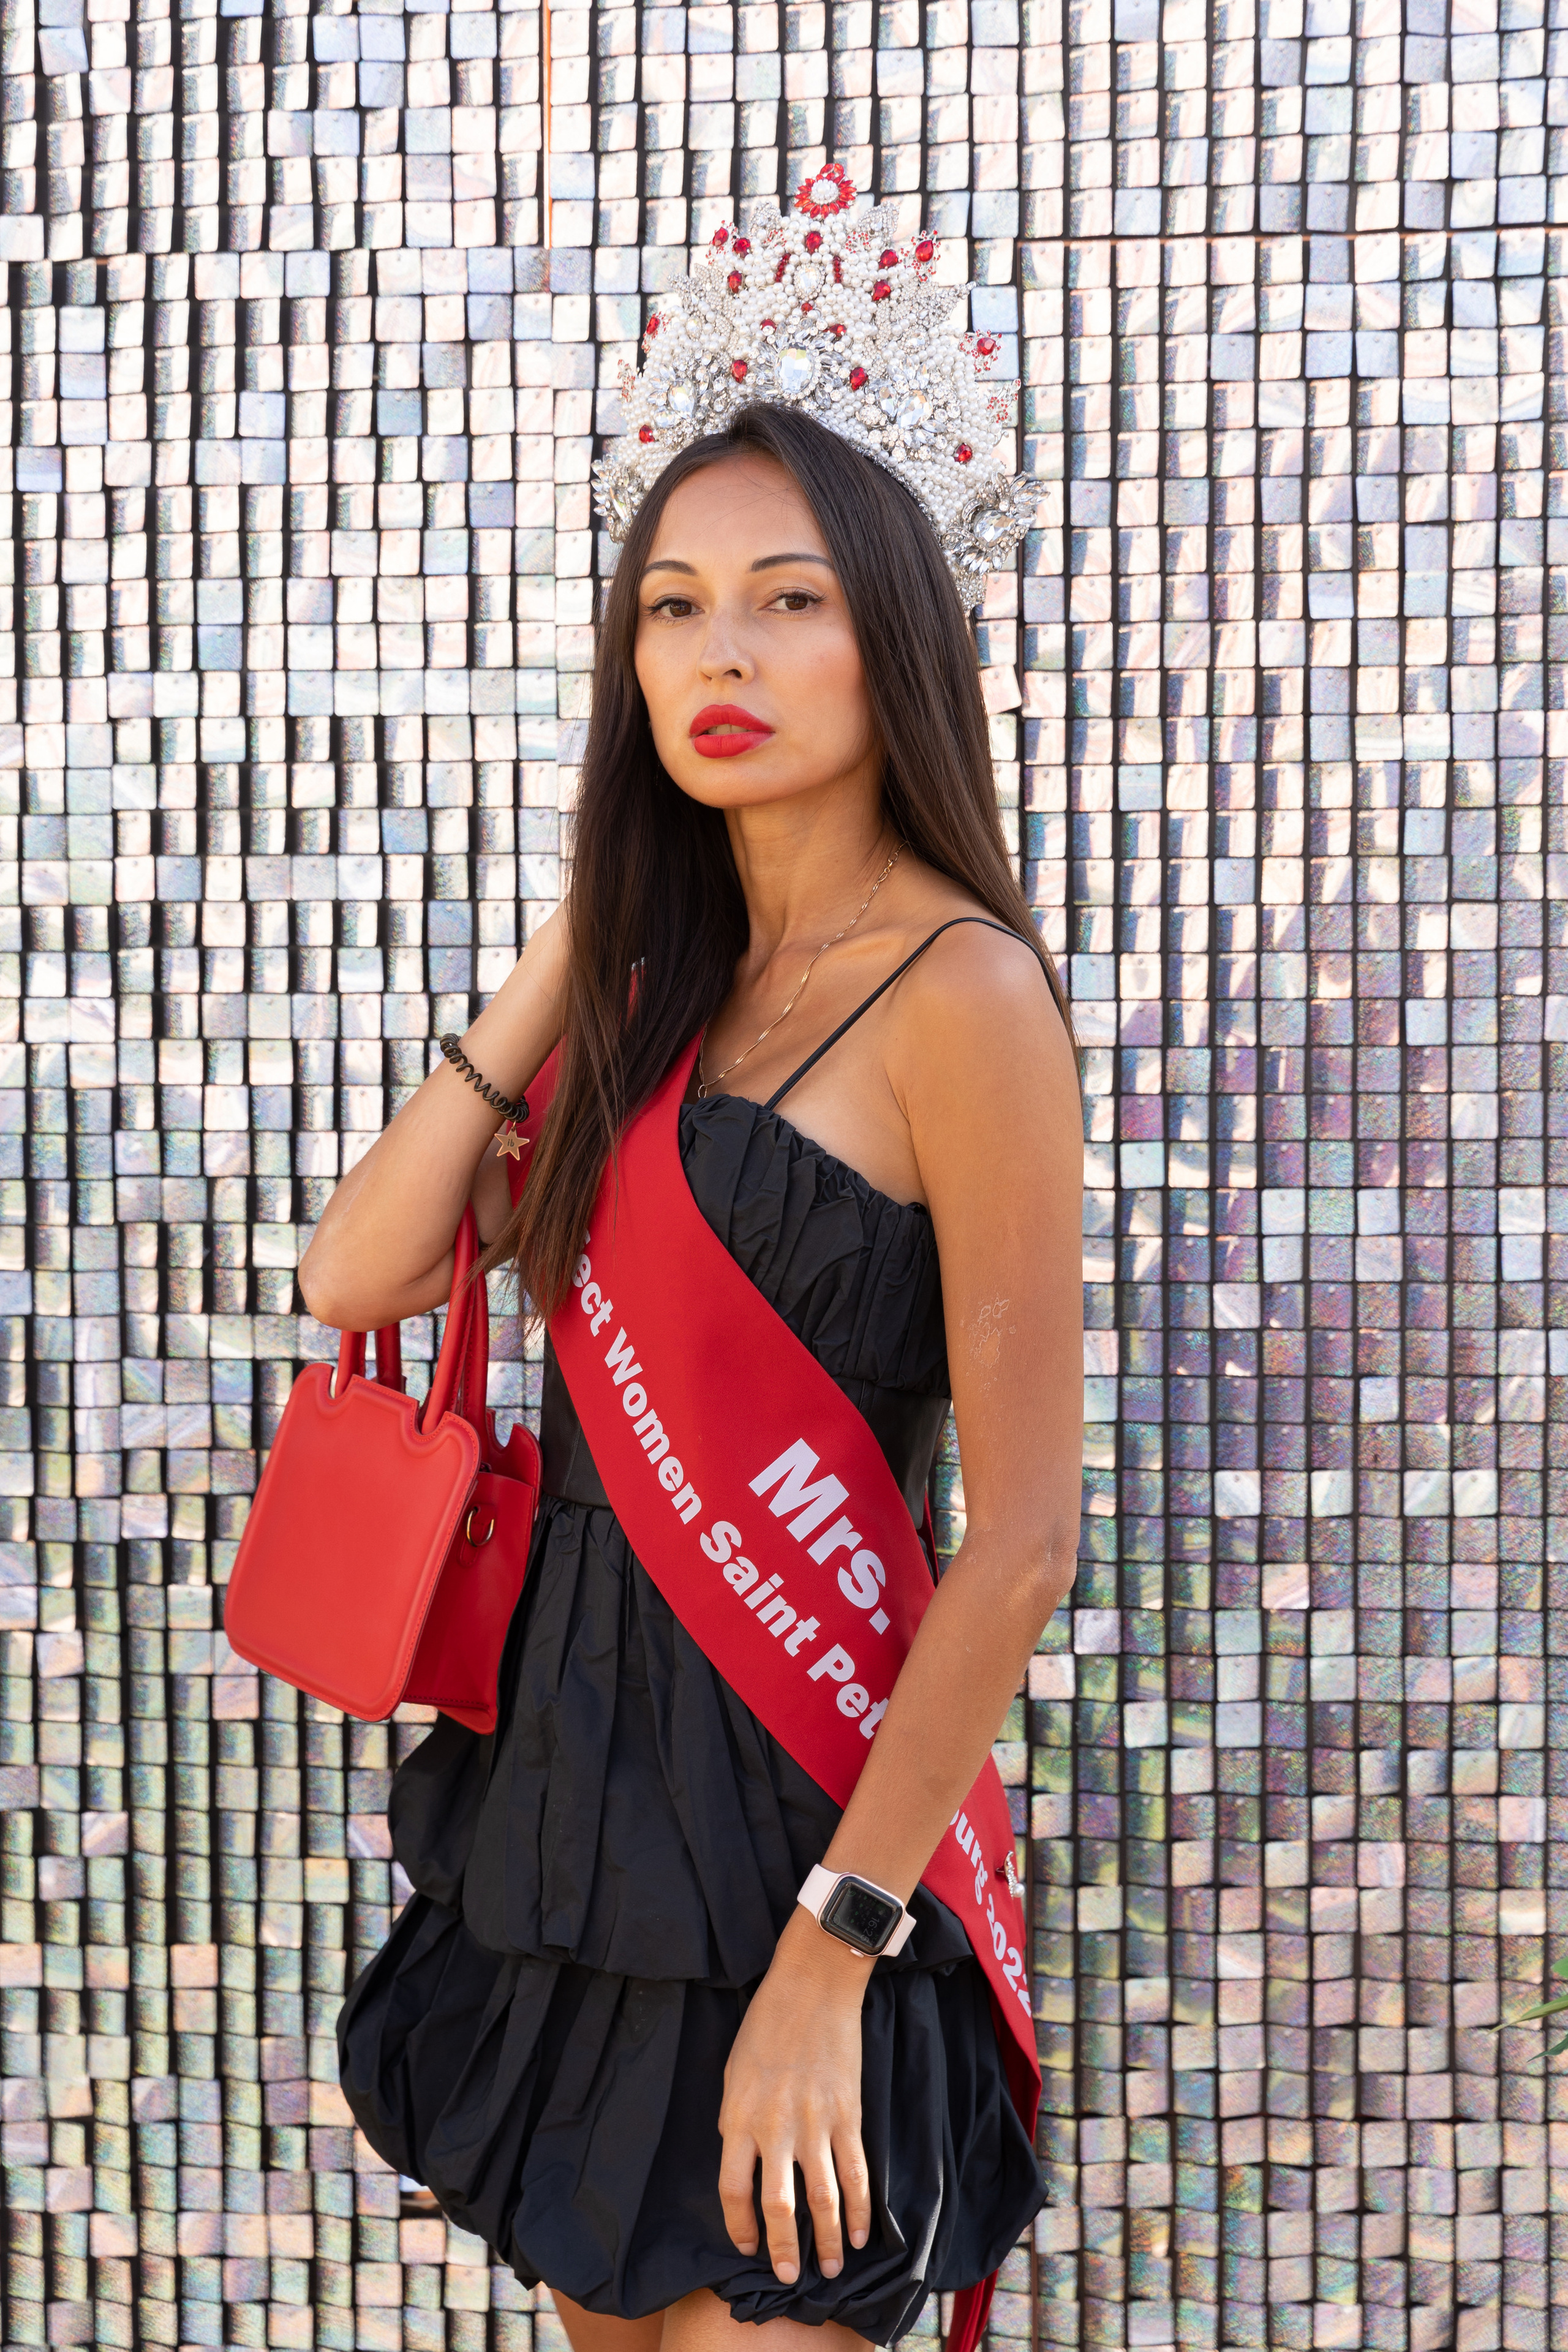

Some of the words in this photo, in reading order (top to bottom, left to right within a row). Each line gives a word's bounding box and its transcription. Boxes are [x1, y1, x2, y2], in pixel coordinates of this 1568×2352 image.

[571, 1229, 614, 1338] ect
[605, 1326, 702, 1525] Women
[700, 1520, 821, 1657] Saint
[807, 1643, 889, 1740] Pet
[949, 1809, 988, 1905] urg
[748, 1438, 891, 1635] Mrs.
